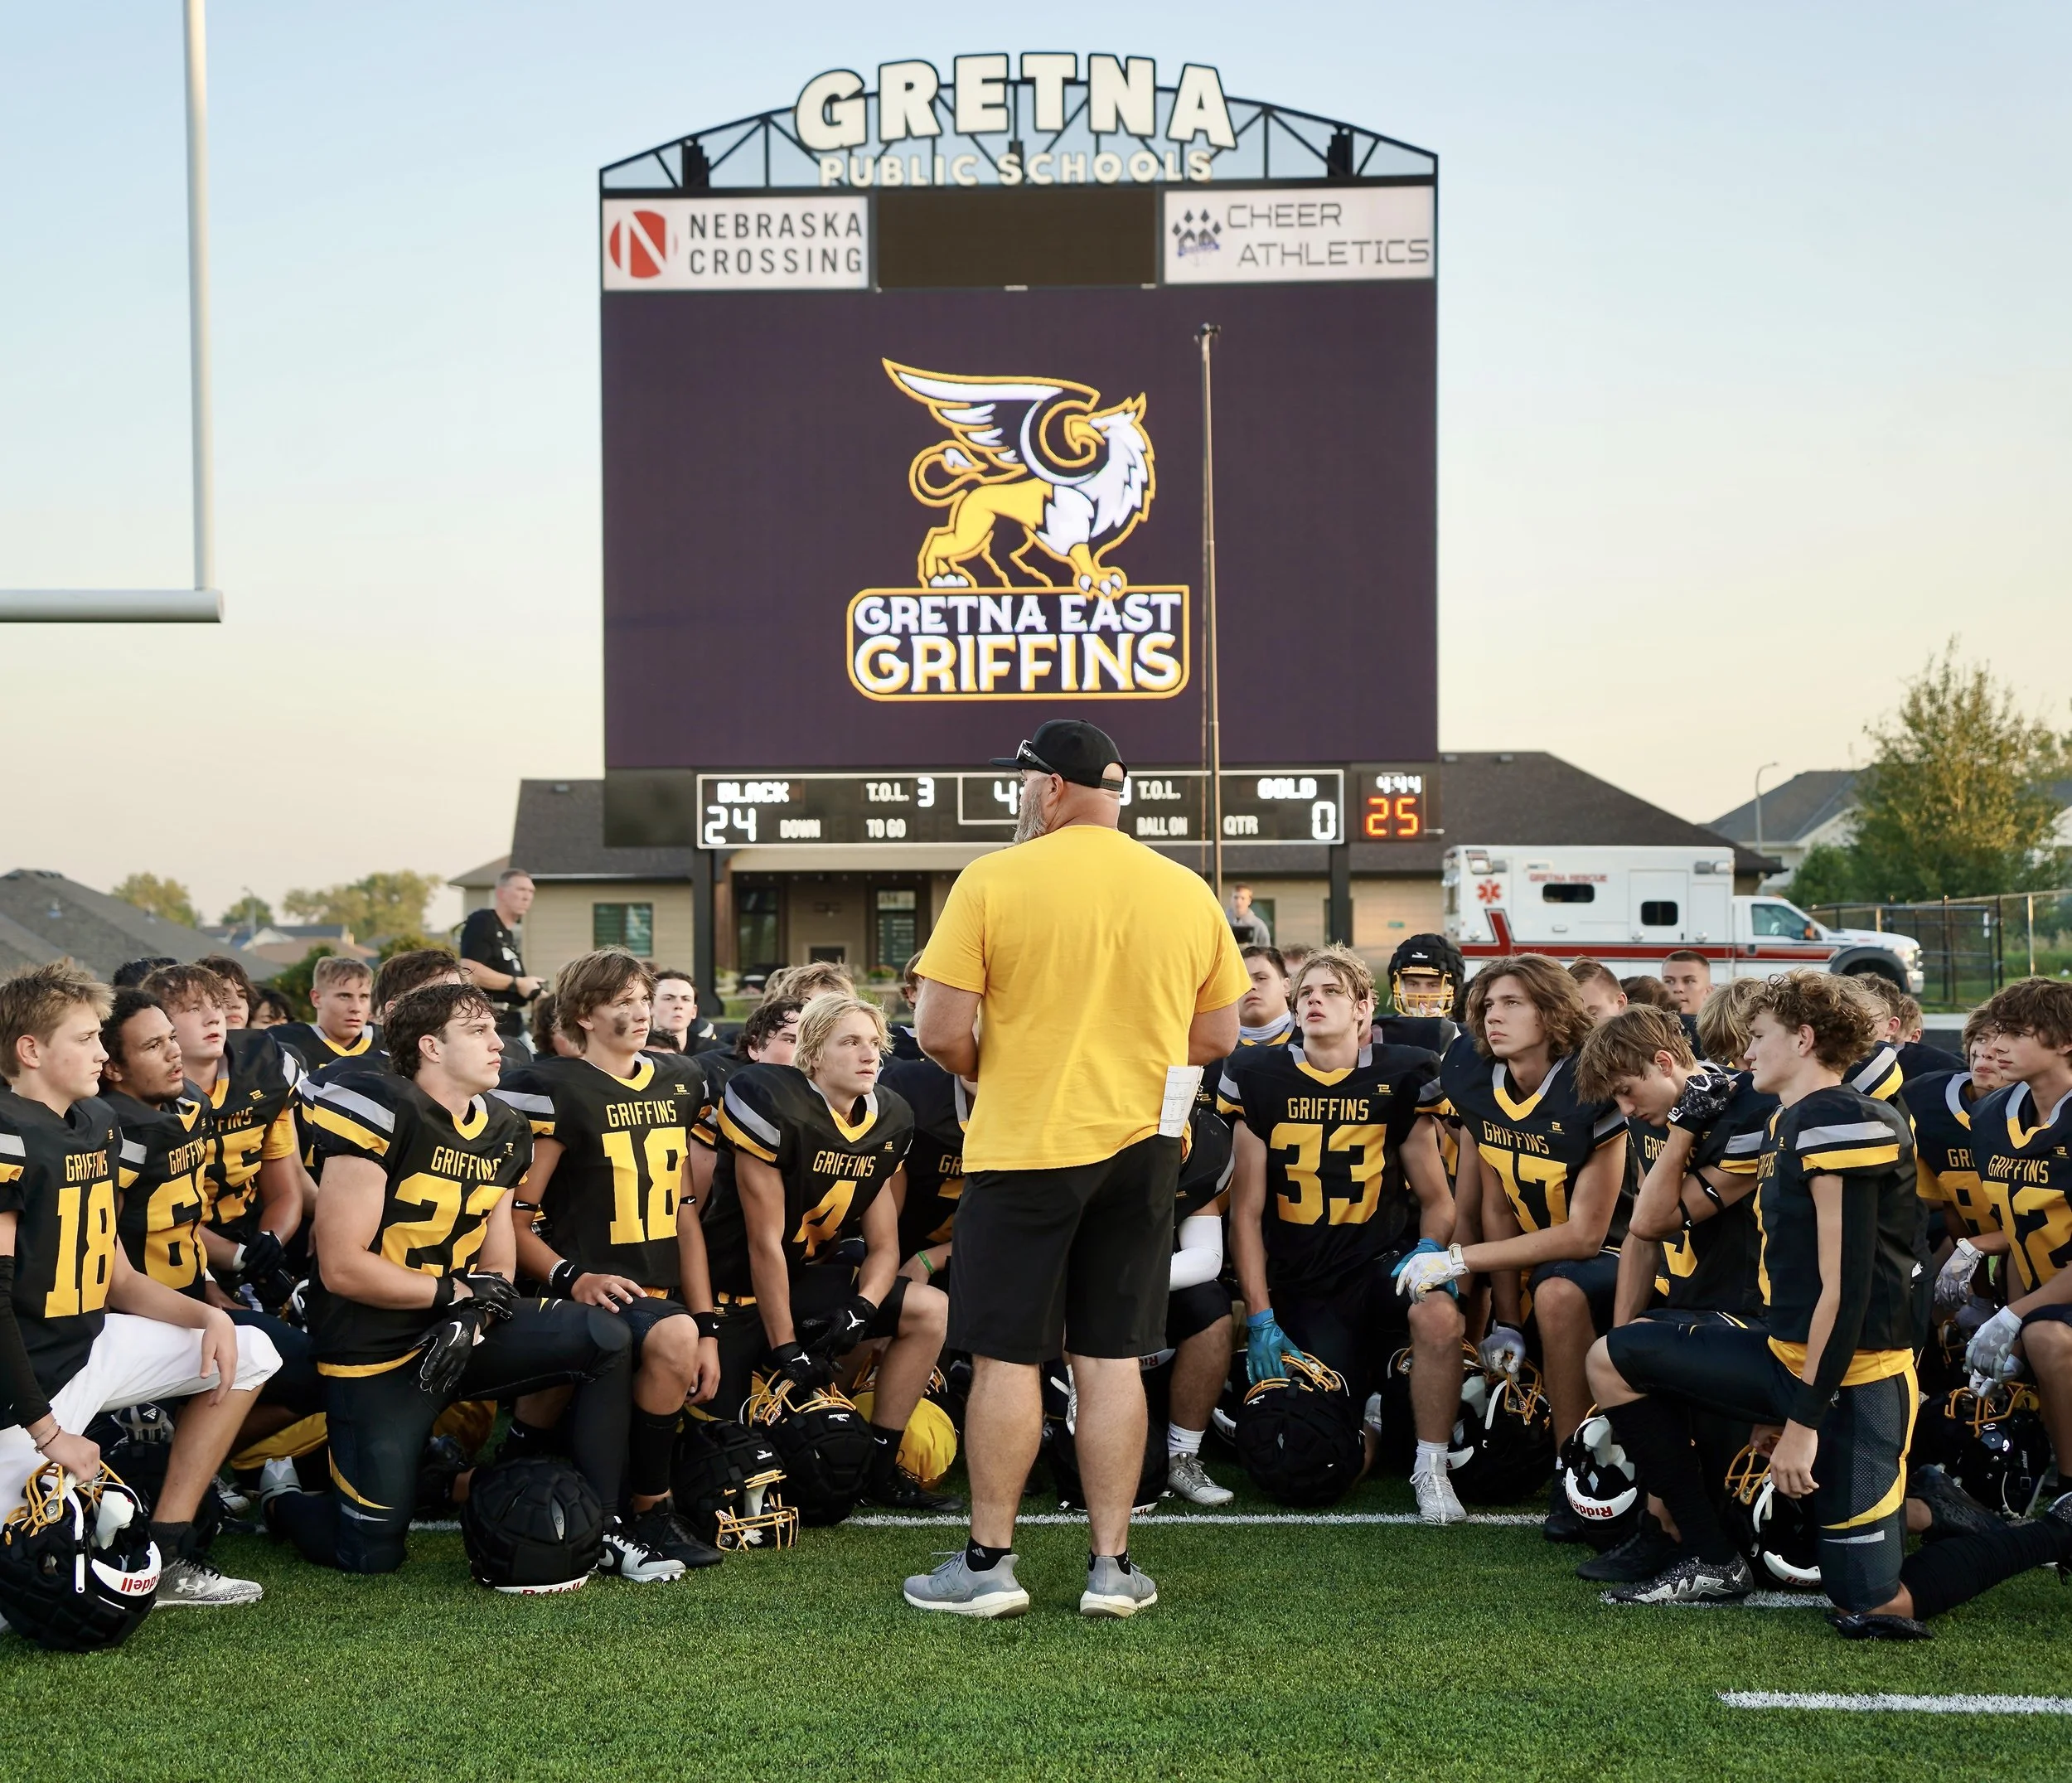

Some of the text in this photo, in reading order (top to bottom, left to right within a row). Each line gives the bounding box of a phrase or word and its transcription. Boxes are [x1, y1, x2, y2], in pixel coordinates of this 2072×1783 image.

[796, 52, 1238, 151] GRETNA
[819, 150, 1213, 188] PUBLIC SCHOOLS
[690, 212, 863, 240] NEBRASKA
[1227, 203, 1343, 229] CHEER
[690, 248, 863, 276] CROSSING
[1237, 240, 1431, 267] ATHLETICS
[854, 594, 1182, 634] GRETNA EAST
[854, 632, 1183, 694] GRIFFINS
[717, 782, 790, 803] BLACK
[917, 777, 935, 807] 3
[1257, 778, 1317, 799] GOLD
[704, 805, 758, 845] 24
[780, 819, 821, 839] DOWN
[866, 819, 884, 838] TO
[886, 819, 907, 838] GO
[1168, 816, 1188, 836] ON
[1223, 815, 1259, 836] QTR
[1311, 801, 1337, 841] 0
[1366, 797, 1420, 836] 25
[606, 1099, 677, 1128] GRIFFINS
[1287, 1097, 1370, 1121] GRIFFINS
[1483, 1120, 1550, 1156] GRIFFINS
[65, 1149, 108, 1182] GRIFFINS
[430, 1146, 502, 1181] GRIFFINS
[812, 1151, 877, 1177] GRIFFINS
[1270, 1122, 1387, 1225] 33
[1988, 1154, 2050, 1184] GRIFFINS
[601, 1126, 690, 1244] 18
[380, 1171, 508, 1277] 22
[792, 1180, 858, 1261] 4
[44, 1180, 117, 1319] 18
[1567, 1492, 1614, 1518] Riddell
